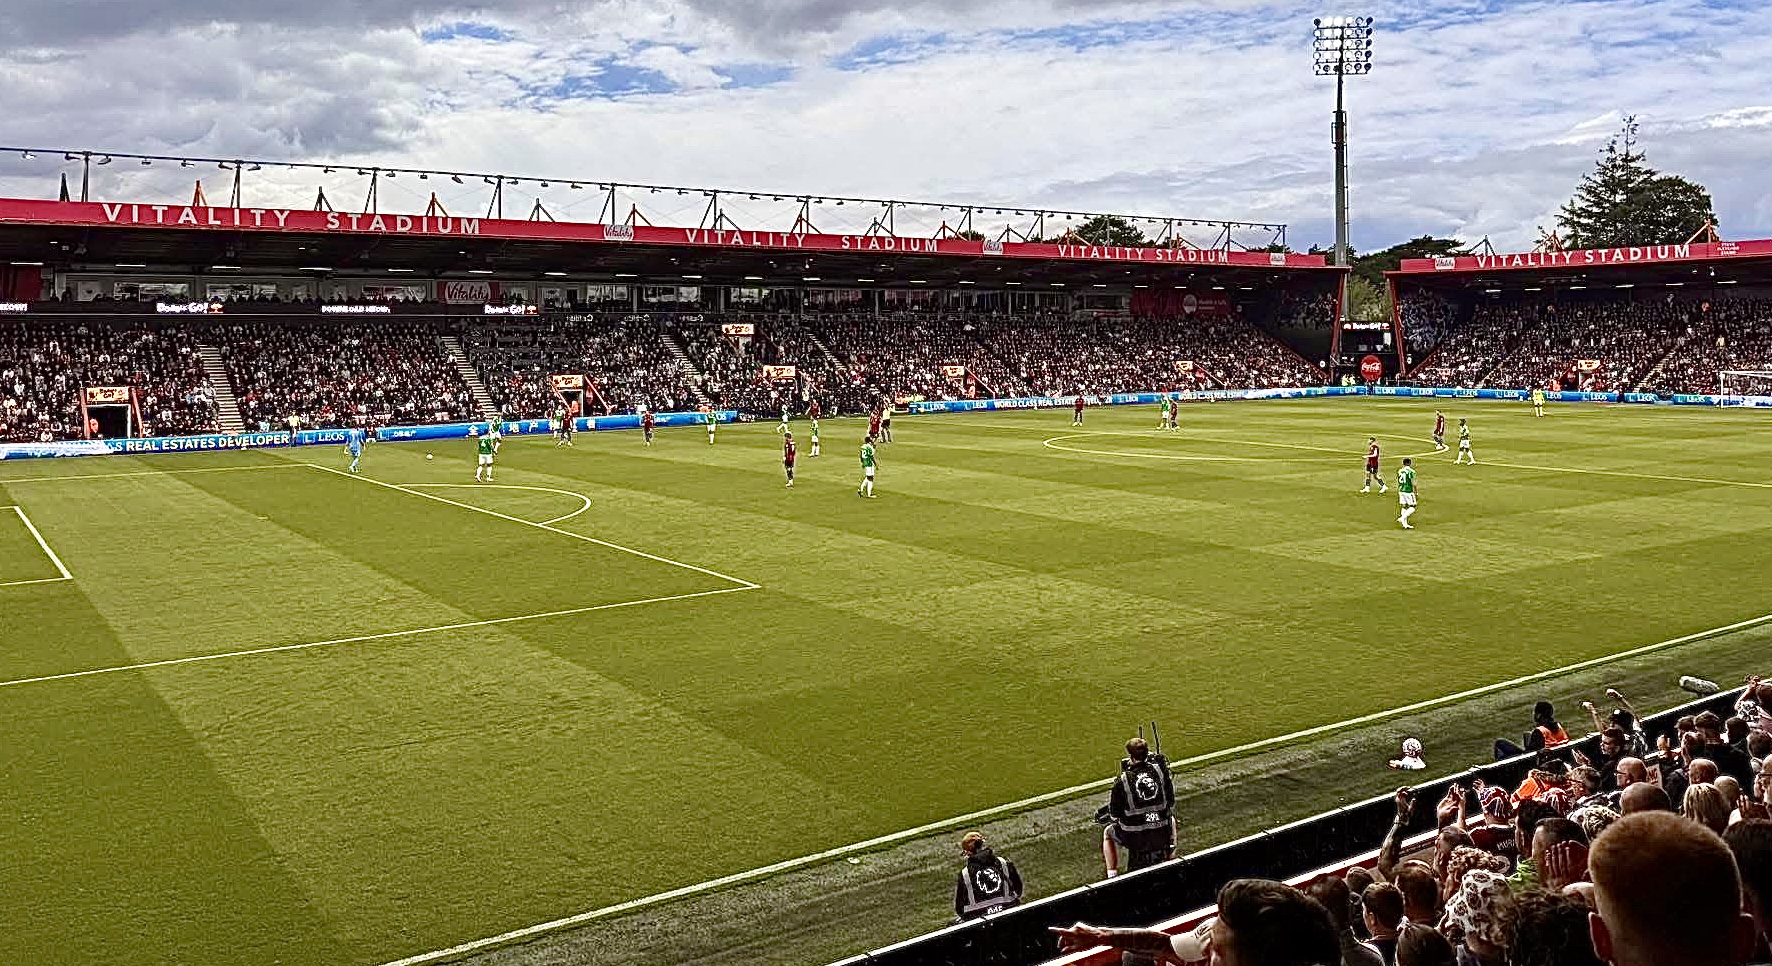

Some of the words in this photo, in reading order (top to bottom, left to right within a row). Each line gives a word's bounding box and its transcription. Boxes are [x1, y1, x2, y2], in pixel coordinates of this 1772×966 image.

[102, 203, 290, 227] VITALITY
[327, 212, 480, 235] STADIUM
[604, 225, 633, 239] Vitality
[685, 229, 806, 248] VITALITY
[841, 235, 938, 253] STADIUM
[1057, 244, 1146, 261] VITALITY
[1156, 249, 1229, 264] STADIUM
[1477, 251, 1573, 268] VITALITY
[1585, 244, 1690, 263] STADIUM
[446, 281, 491, 301] Vitality
[994, 400, 1018, 408] WORLD
[1018, 399, 1038, 408] CLASS
[1038, 399, 1054, 407] REAL
[126, 438, 160, 452] REAL
[162, 437, 216, 451] ESTATES
[218, 434, 290, 450] DEVELOPER
[317, 432, 345, 442] LEOS
[1145, 812, 1160, 822] 291
